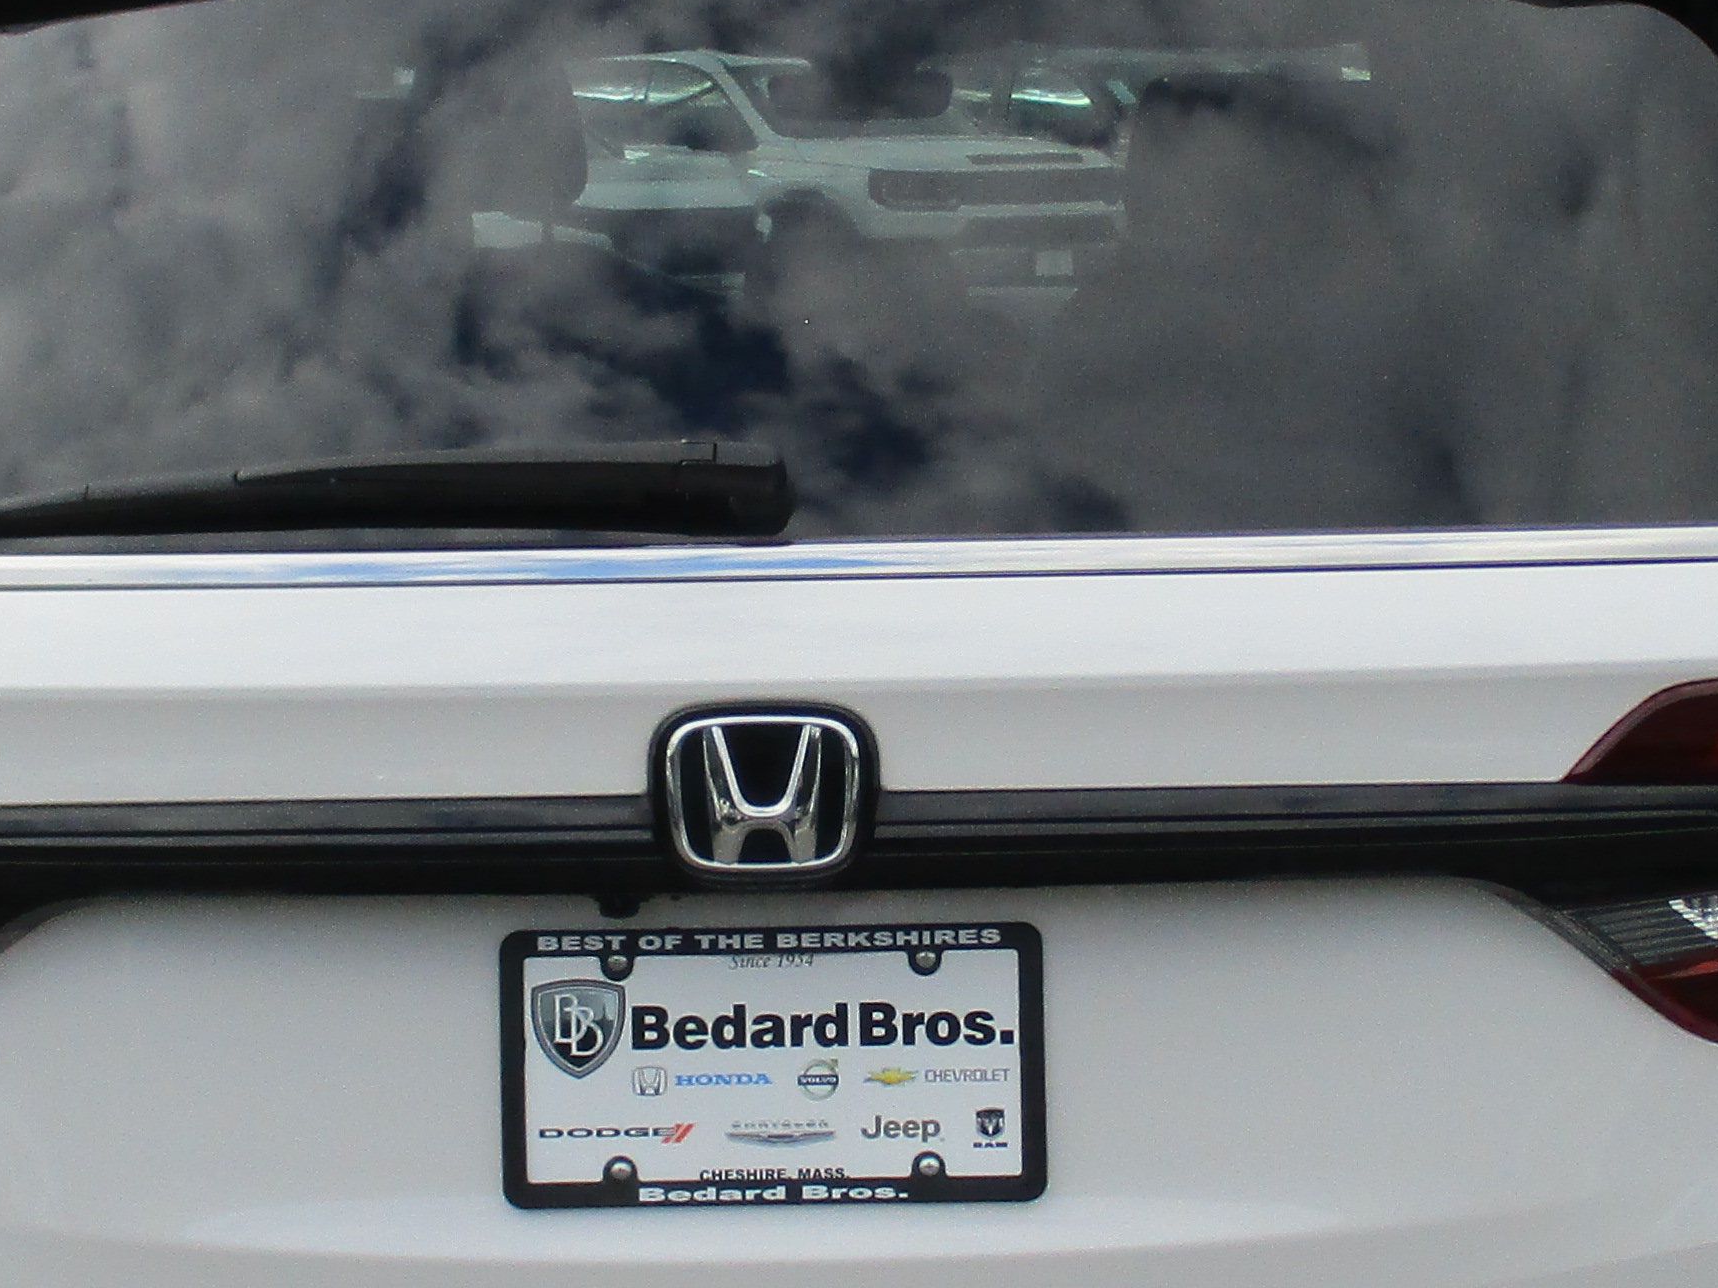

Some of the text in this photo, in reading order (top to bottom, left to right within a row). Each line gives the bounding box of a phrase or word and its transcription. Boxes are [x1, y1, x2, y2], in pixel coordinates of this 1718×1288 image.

[537, 928, 1002, 952] BEST OF THE BERKSHIRES
[728, 954, 771, 971] Since
[632, 1001, 1015, 1051] Bedard Bros.
[674, 1073, 772, 1087] HONDA
[800, 1076, 838, 1086] VOLVO
[924, 1068, 1011, 1083] CHEVROLET
[539, 1127, 676, 1139] DODGE
[860, 1115, 941, 1143] Jeep
[638, 1185, 909, 1202] Bedard Bros.
